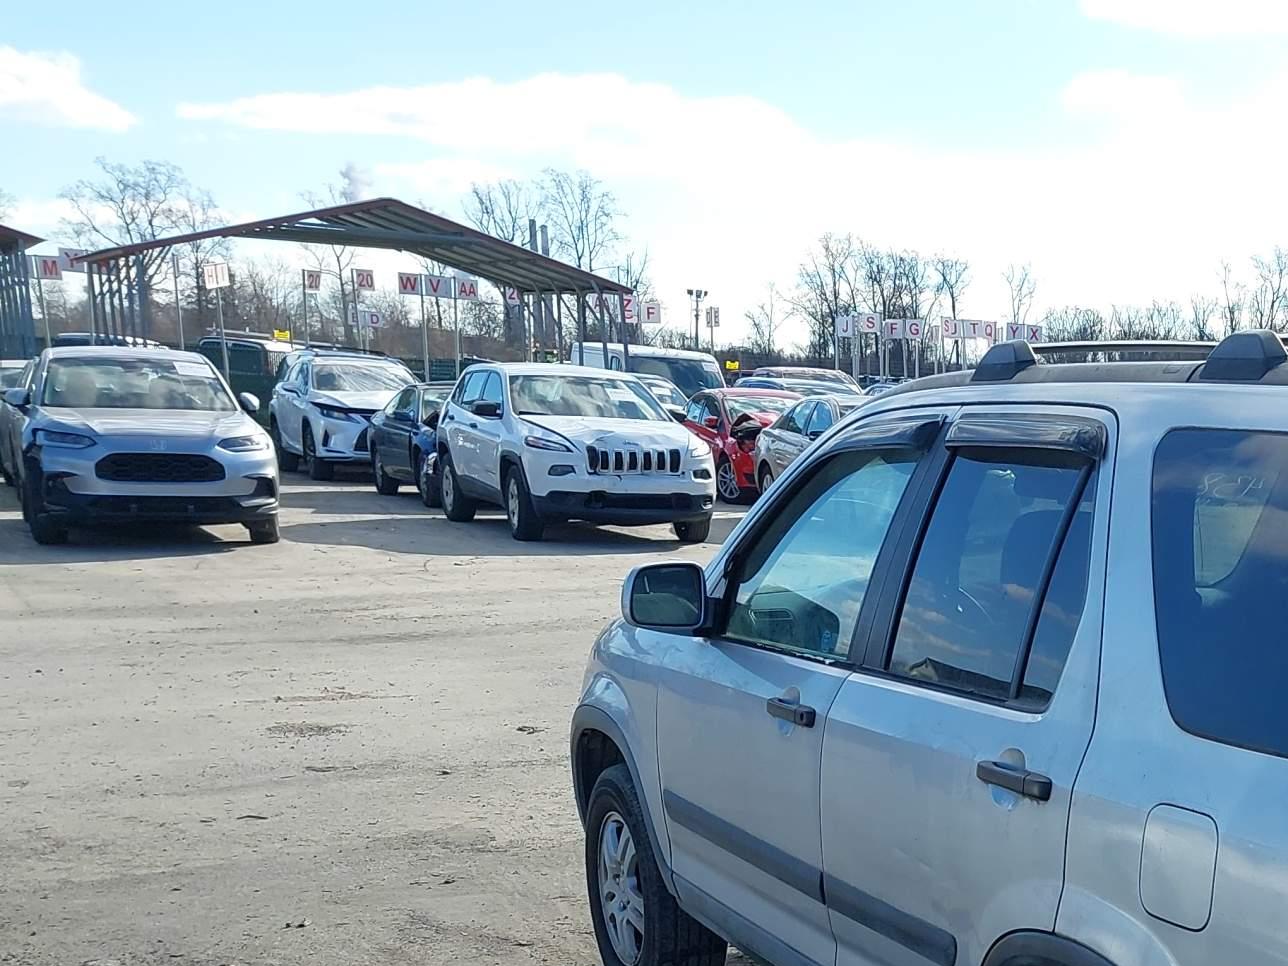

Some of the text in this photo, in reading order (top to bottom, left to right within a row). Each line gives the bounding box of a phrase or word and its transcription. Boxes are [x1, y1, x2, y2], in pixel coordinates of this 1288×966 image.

[42, 259, 58, 276] M
[307, 274, 321, 289] 20
[357, 273, 374, 288] 20
[400, 277, 417, 292] W
[429, 278, 441, 293] V
[459, 282, 476, 297] AA
[370, 313, 380, 325] D
[646, 306, 656, 320] F
[841, 320, 849, 333] J
[866, 316, 876, 329] S
[890, 322, 898, 335] F
[909, 322, 920, 336] G
[969, 322, 979, 335] T
[1009, 326, 1019, 339] Y
[1030, 327, 1039, 341] X
